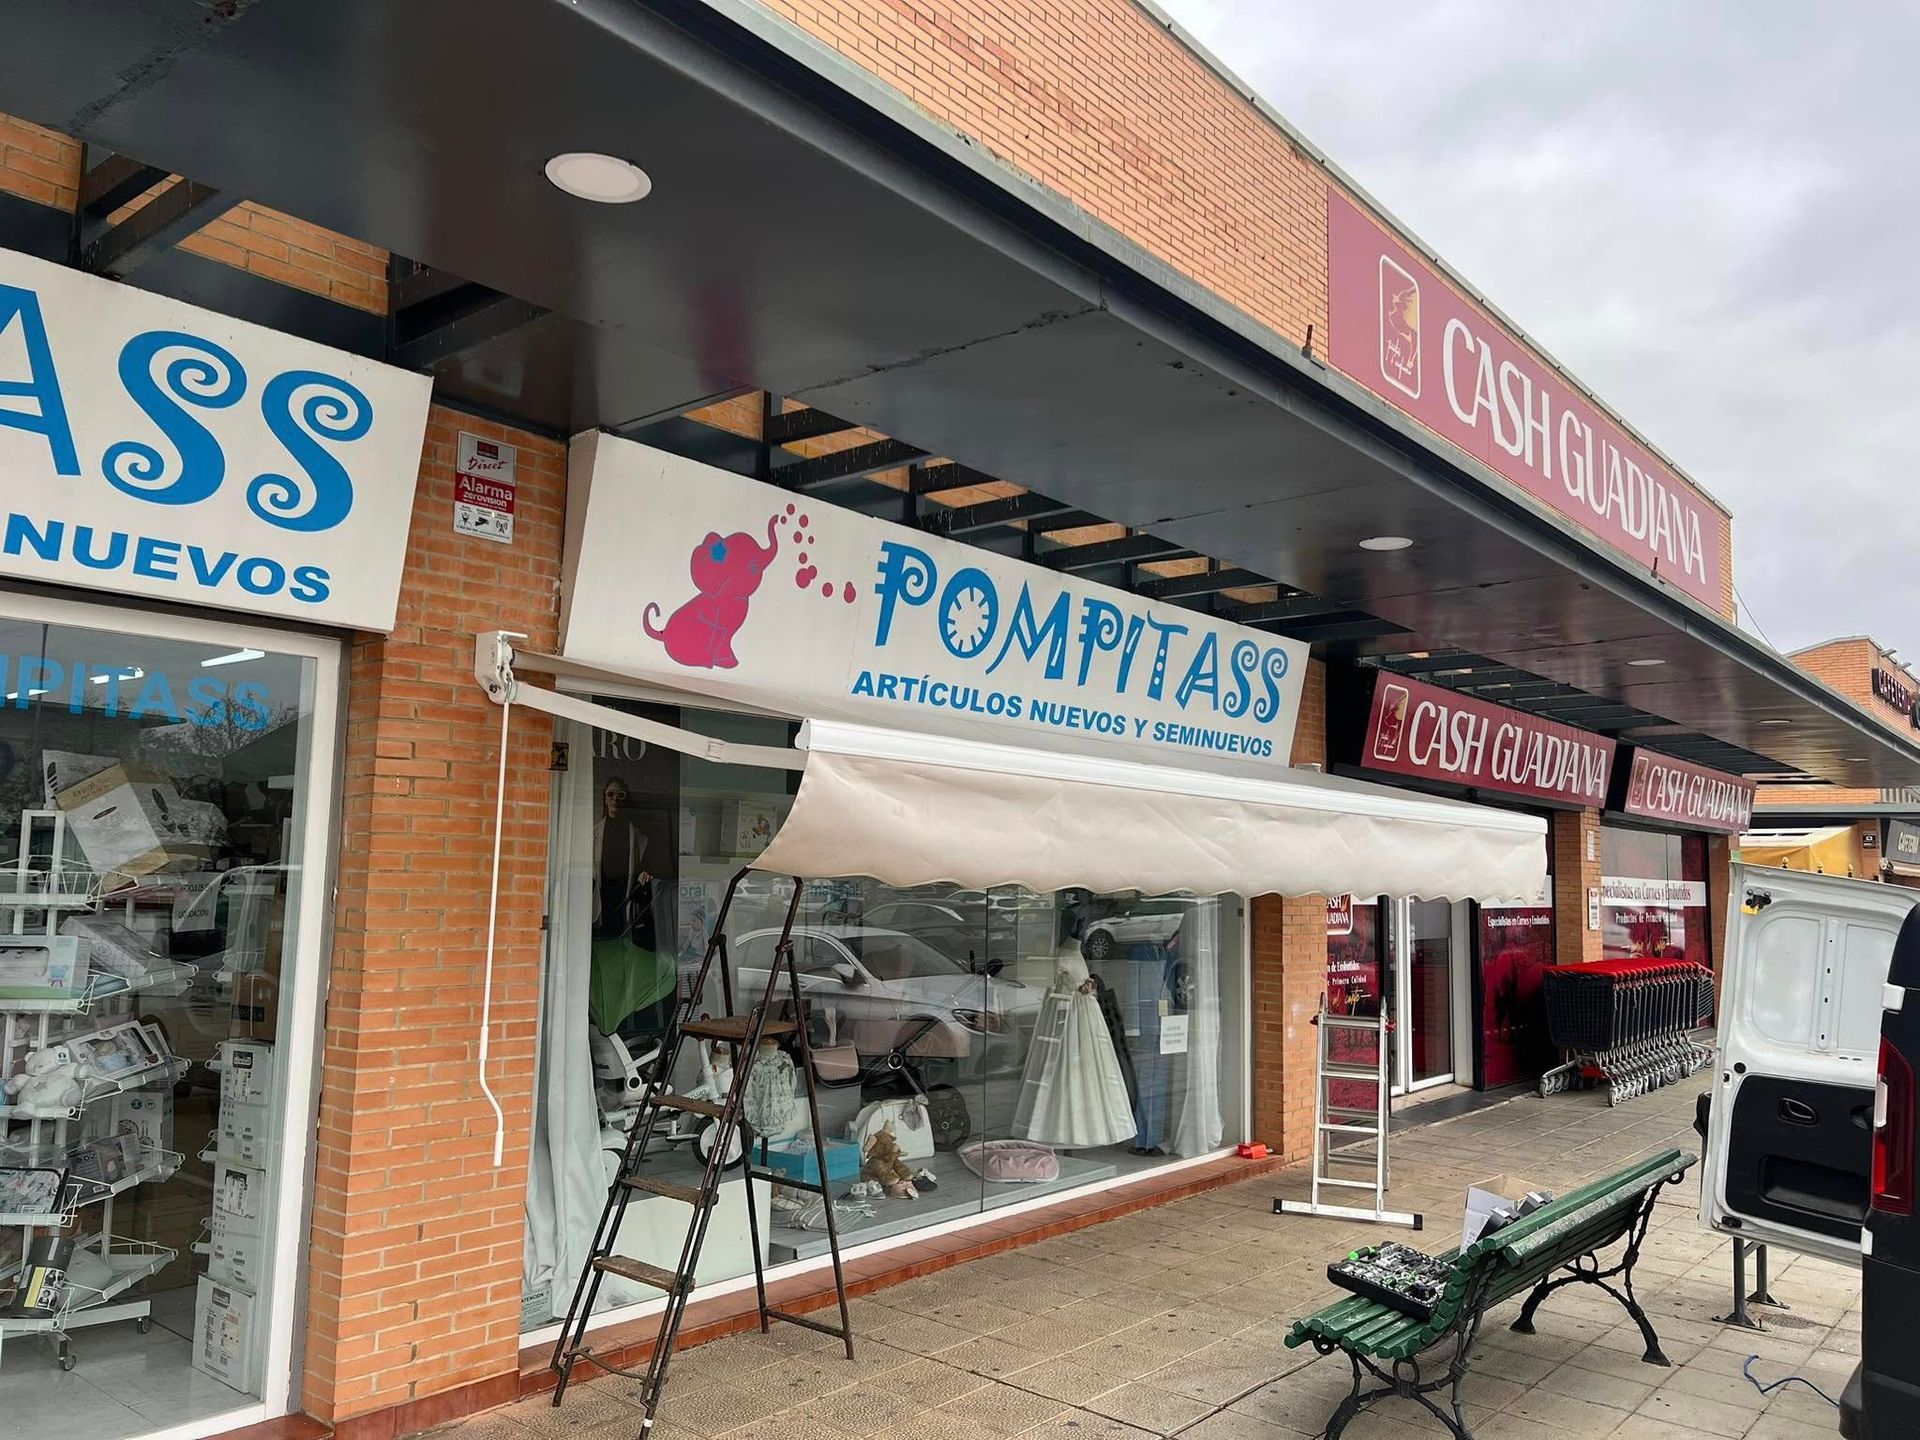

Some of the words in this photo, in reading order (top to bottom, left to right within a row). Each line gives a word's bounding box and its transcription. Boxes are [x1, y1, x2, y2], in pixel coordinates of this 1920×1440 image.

[459, 475, 513, 501] Alarma
[467, 457, 509, 470] Direct
[1443, 318, 1551, 479] CASH
[1559, 409, 1706, 584] GUADIANA
[3, 513, 331, 602] NUEVOS
[875, 541, 1290, 724] POMPITASS
[0, 655, 272, 731] PITASS
[851, 670, 1022, 718] ARTÍCULOS
[1029, 698, 1127, 735] NUEVOS
[1133, 716, 1149, 738] Y
[1152, 720, 1273, 757] SEMINUEVOS
[593, 728, 647, 762] RO
[1408, 700, 1491, 775] CASH
[1491, 722, 1608, 799] GUADIANA
[1646, 765, 1686, 811] CASH
[1687, 774, 1752, 826] GUADIANA
